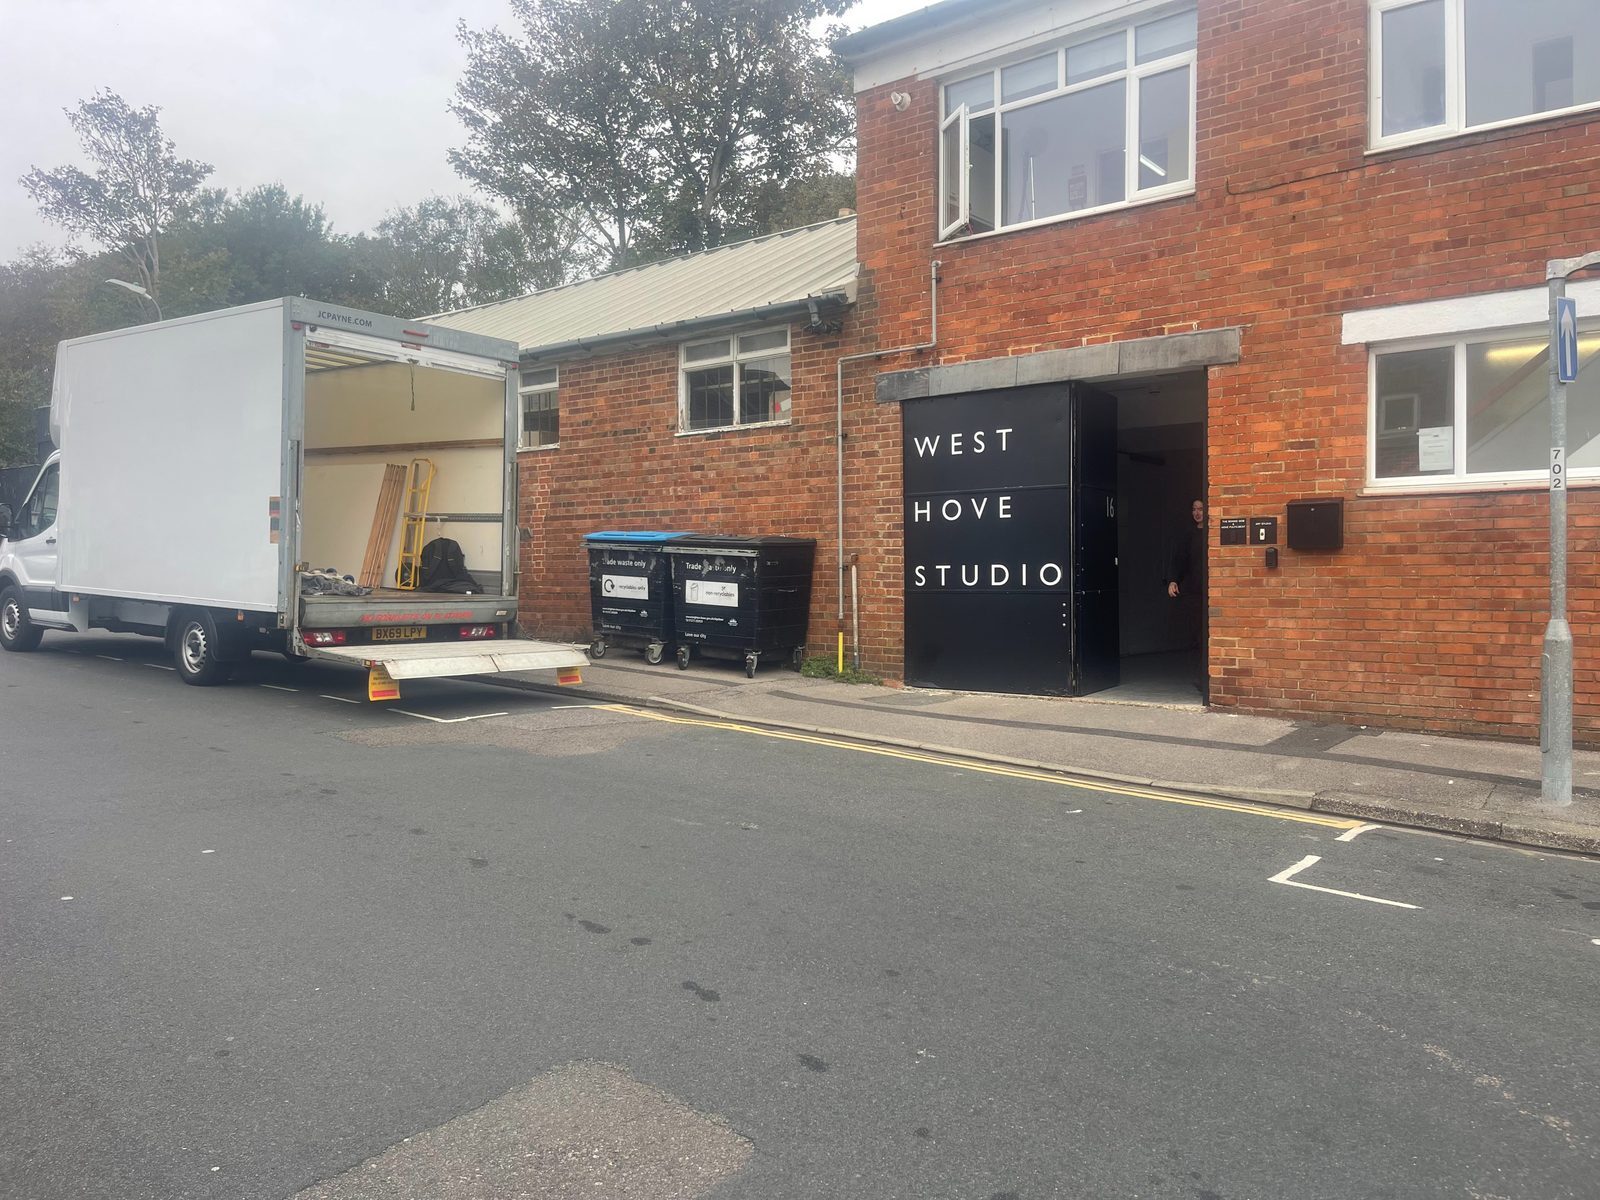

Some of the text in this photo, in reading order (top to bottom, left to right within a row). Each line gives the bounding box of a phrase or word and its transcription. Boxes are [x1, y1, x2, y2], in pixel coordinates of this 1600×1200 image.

[318, 311, 372, 328] JCPAYNE.COM
[914, 429, 1013, 458] WEST
[1552, 449, 1562, 489] 702
[914, 496, 1012, 522] HOVE
[1106, 495, 1115, 518] 16
[634, 560, 646, 569] only
[686, 562, 702, 570] Trade
[914, 563, 1062, 586] STUDIO
[375, 627, 423, 639] BX69 LPY
